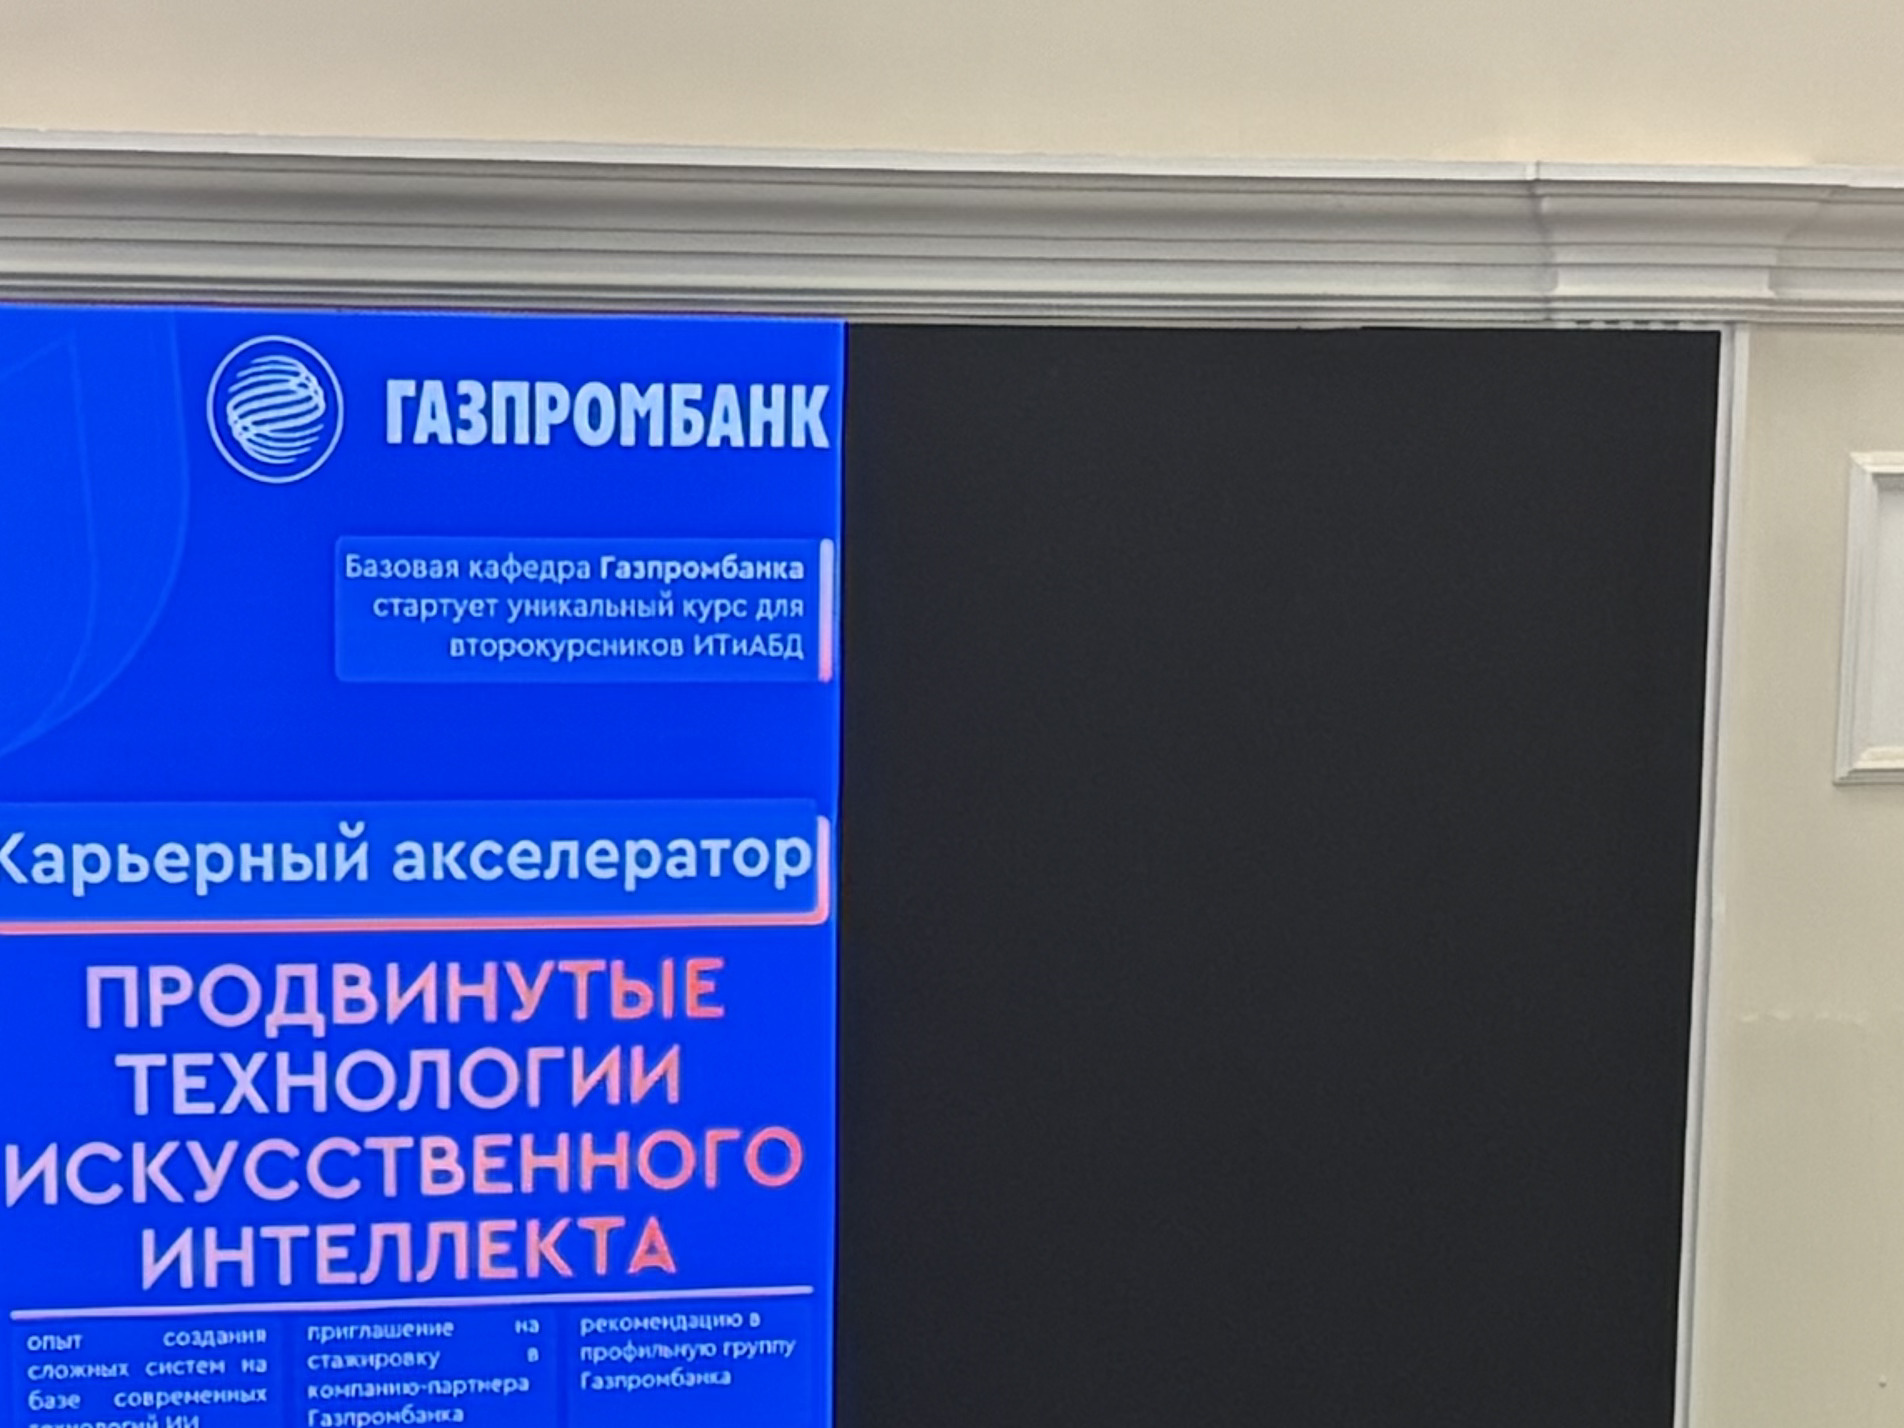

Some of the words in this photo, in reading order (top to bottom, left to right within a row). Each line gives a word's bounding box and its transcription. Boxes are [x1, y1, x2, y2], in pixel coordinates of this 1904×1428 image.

[386, 379, 830, 449] ГАЗПРОМБАНК
[345, 553, 460, 579] Базовая
[469, 552, 591, 585] кафедра
[600, 553, 805, 585] Газпромбанка
[372, 597, 499, 624] стартует
[507, 589, 674, 624] уникальный
[682, 598, 748, 624] курс
[755, 598, 804, 622] для
[449, 637, 684, 663] второкурсников
[693, 633, 805, 661] ИТиАБД
[392, 836, 813, 892] акселератор
[86, 956, 725, 1039] ПРОДВИНУТЫЕ
[114, 1043, 681, 1116] ТЕХНОЛОГИИ
[5, 1125, 804, 1207] ИСКУССТВЕННОГО
[142, 1215, 677, 1291] ИНТЕЛЛЕКТА
[307, 1321, 455, 1345] приглашение
[514, 1319, 540, 1334] на
[580, 1312, 744, 1337] рекомендацию
[749, 1311, 761, 1328] в
[26, 1334, 83, 1351] опыт
[162, 1328, 267, 1348] создания
[580, 1339, 717, 1365] профильную
[722, 1339, 796, 1360] группу
[27, 1363, 129, 1381] сложных
[145, 1359, 226, 1377] систем
[241, 1358, 268, 1373] на
[307, 1351, 441, 1371] стажировку
[527, 1347, 539, 1363] в
[307, 1377, 530, 1399] компанию-партнера
[580, 1366, 732, 1392] Газпромбанка
[28, 1389, 81, 1411] базе
[113, 1388, 267, 1410] современных
